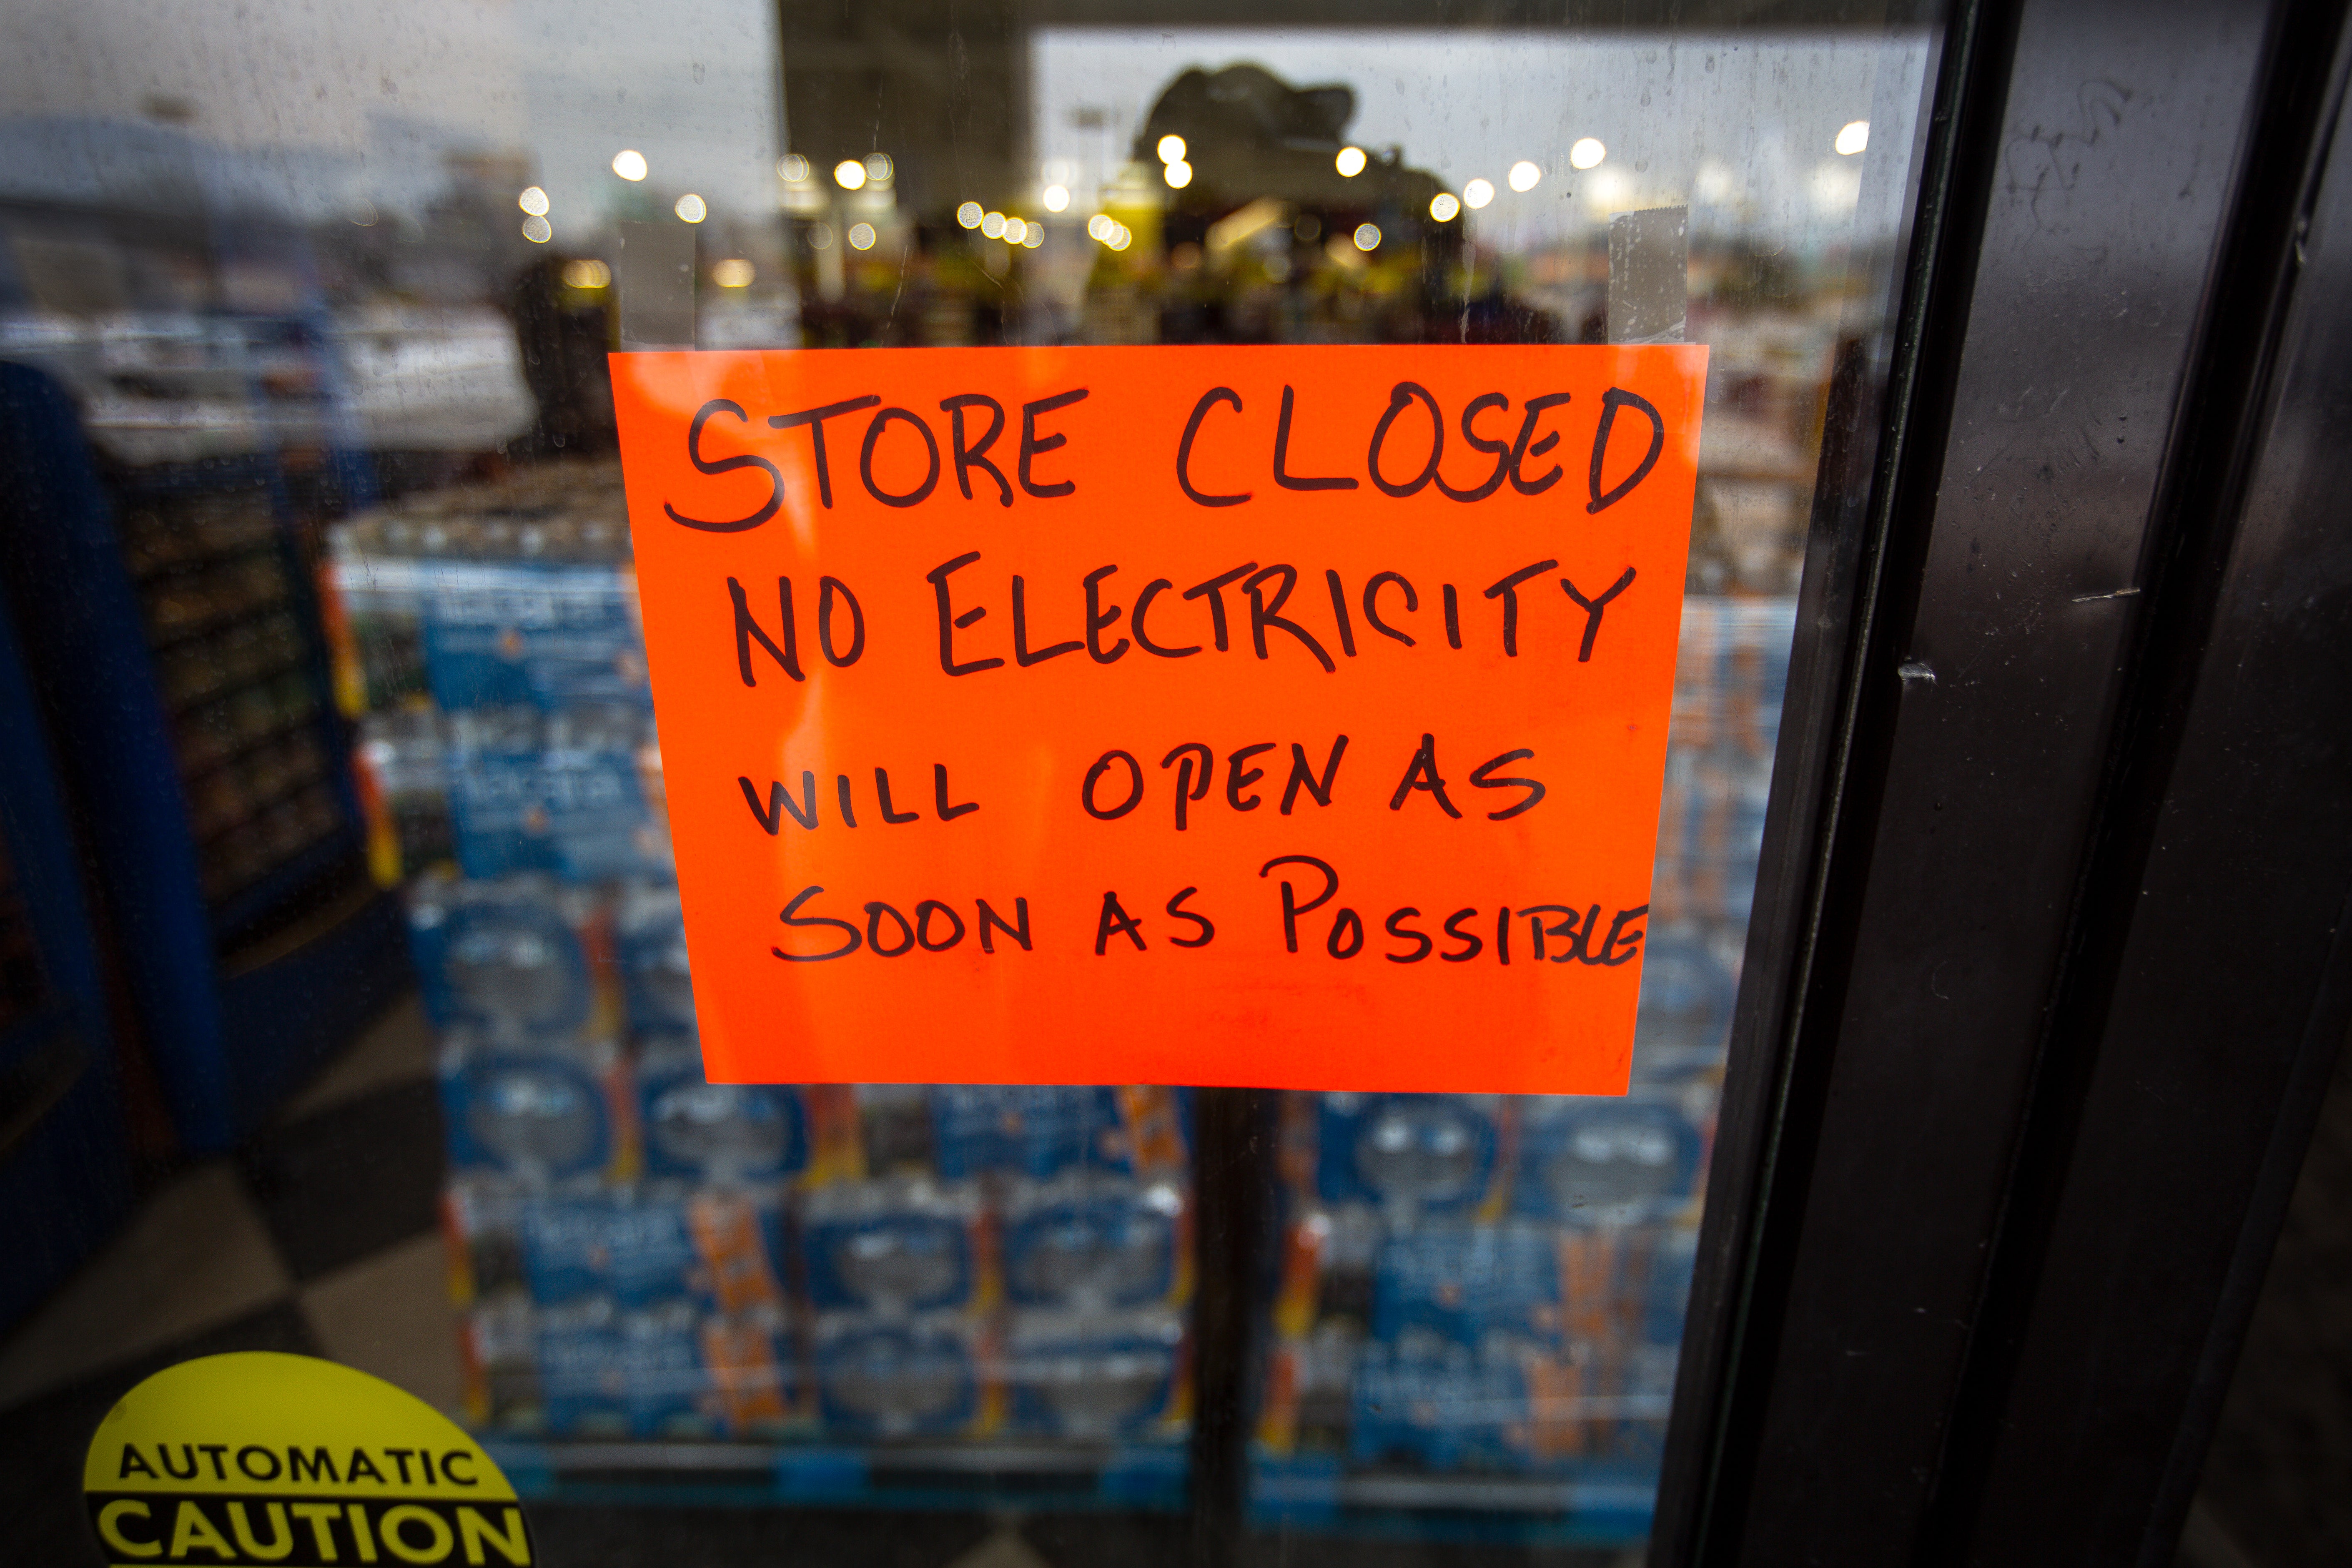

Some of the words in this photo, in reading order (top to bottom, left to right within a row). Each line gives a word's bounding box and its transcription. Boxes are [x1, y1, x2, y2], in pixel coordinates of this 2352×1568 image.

[664, 390, 1089, 533] STORE
[1177, 382, 1664, 514] CLOSED
[727, 576, 865, 687] NO
[927, 551, 1636, 676] ELECTRICITY
[738, 764, 979, 836] WILL
[1082, 735, 1349, 830] OPEN
[1389, 733, 1546, 820] AS
[772, 886, 1032, 962] SOON
[1096, 887, 1214, 955] AS
[118, 1443, 479, 1486] AUTOMATIC
[97, 1500, 532, 1565] CAUTION
